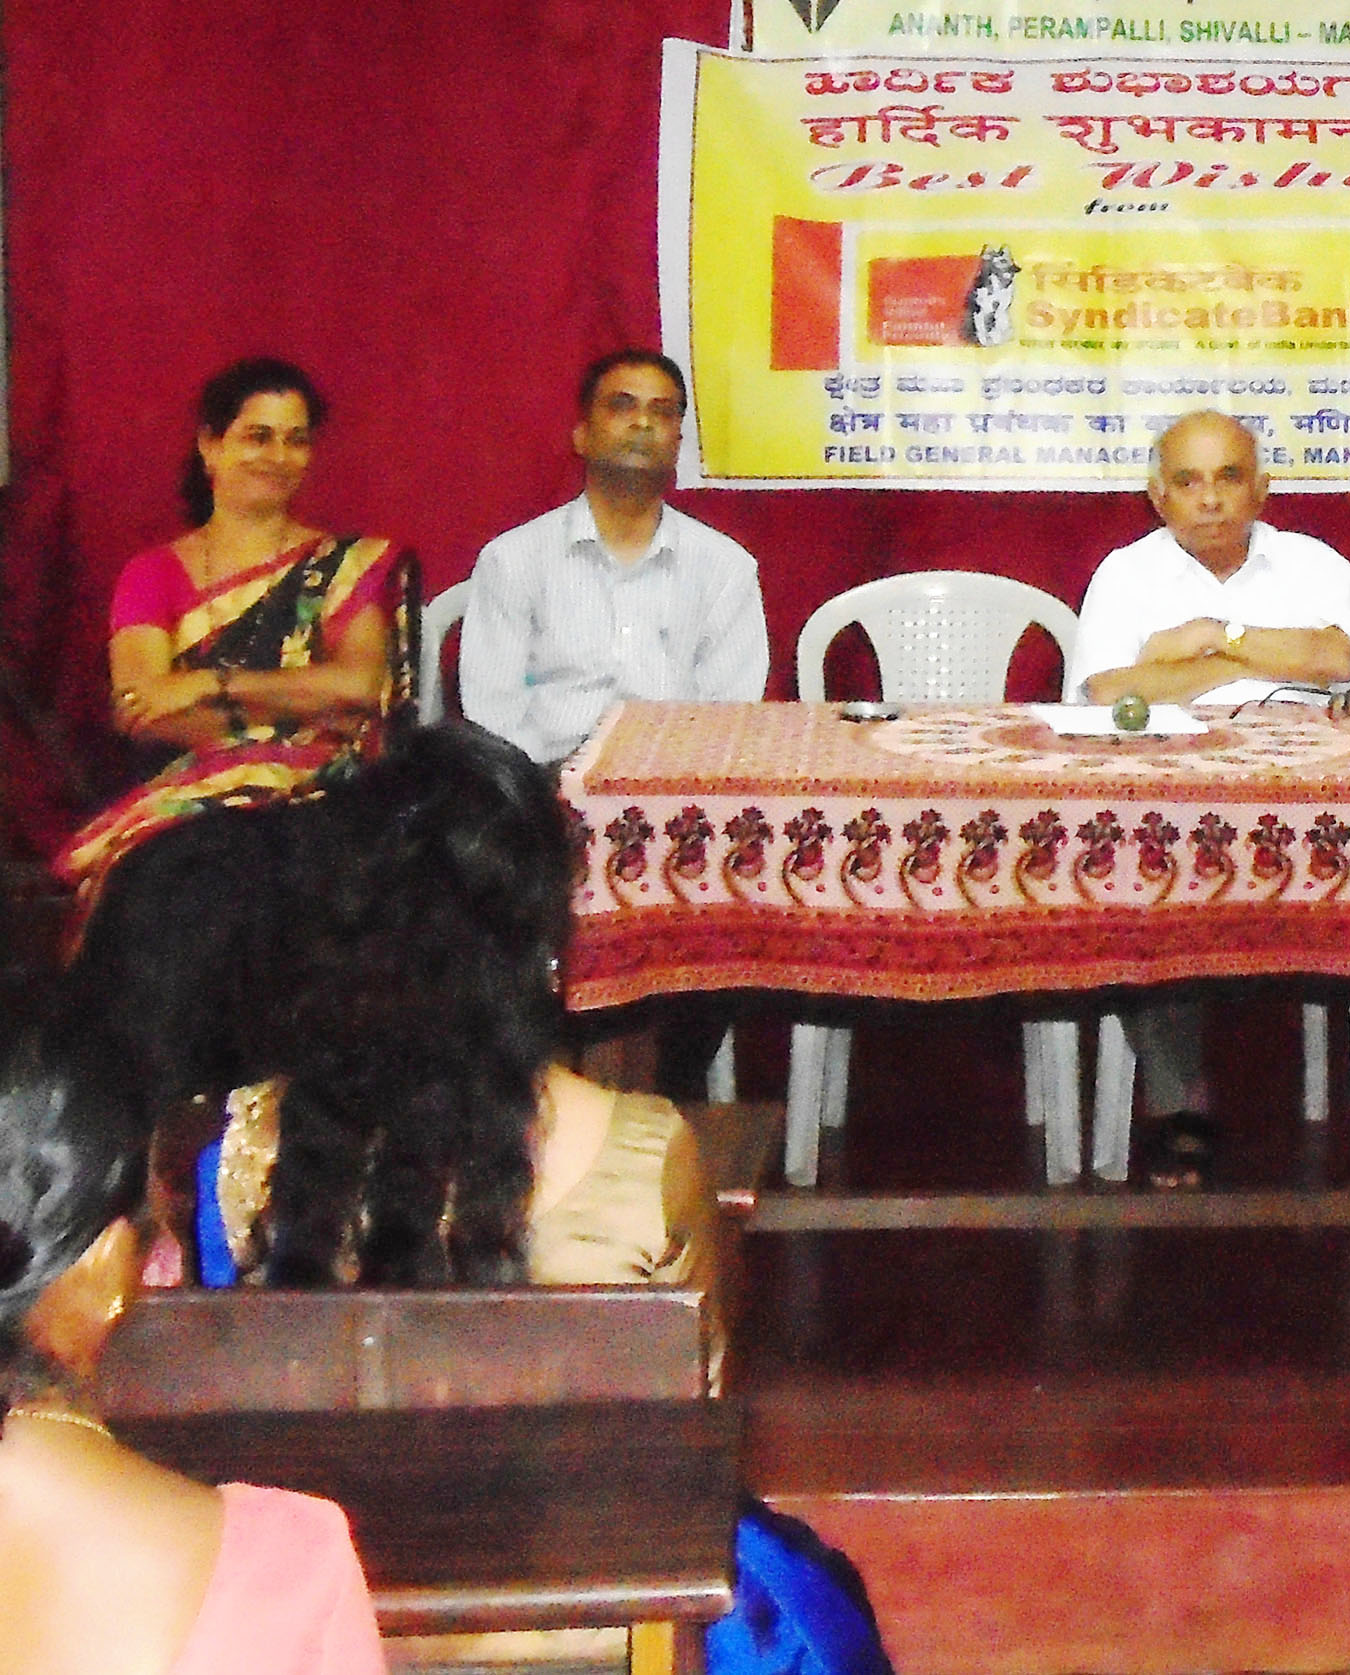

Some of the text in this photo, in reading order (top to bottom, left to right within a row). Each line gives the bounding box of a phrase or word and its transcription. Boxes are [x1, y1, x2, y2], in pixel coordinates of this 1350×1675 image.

[888, 12, 999, 40] ANANTH,
[1008, 16, 1170, 44] PERAMPALLI,
[1180, 19, 1290, 44] SHIVALLI
[800, 104, 1021, 148] हार्दिक
[810, 162, 1034, 190] Best
[824, 445, 896, 463] FIELD
[904, 446, 1027, 464] GENERAL
